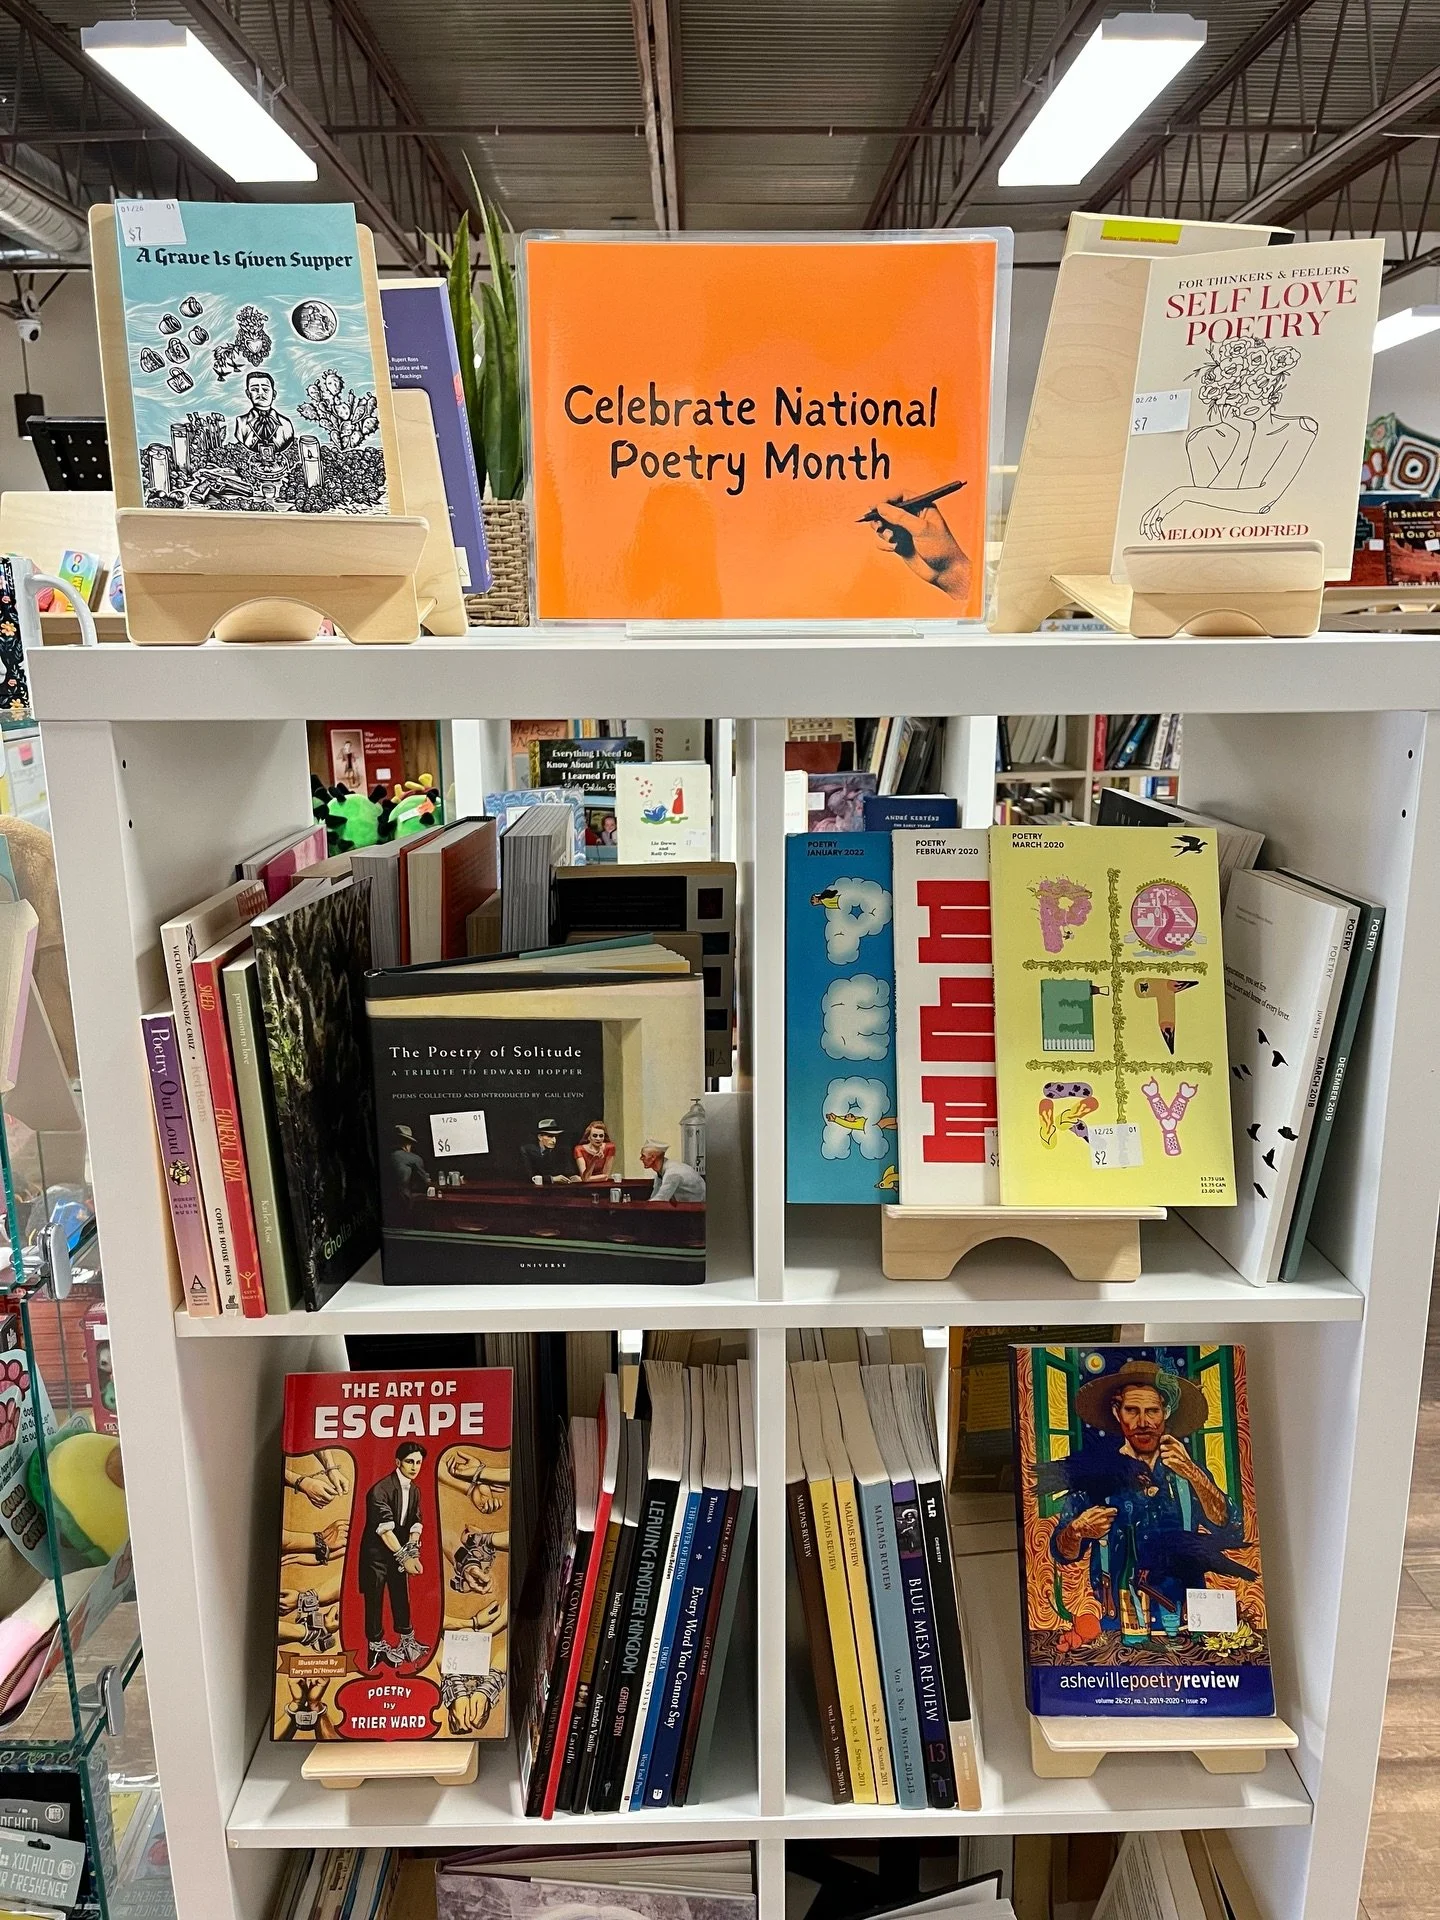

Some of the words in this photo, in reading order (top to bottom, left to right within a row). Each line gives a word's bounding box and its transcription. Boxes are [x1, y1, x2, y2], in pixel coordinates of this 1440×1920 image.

[120, 204, 144, 213] 01/26
[128, 226, 142, 243] $7
[136, 247, 153, 264] A
[155, 248, 210, 266] Grave
[235, 250, 287, 270] Given
[290, 251, 354, 272] Supper
[1178, 279, 1203, 290] FOR
[1206, 271, 1274, 287] THINKERS
[1277, 269, 1287, 280] &
[1291, 265, 1351, 279] FEELERS
[1166, 286, 1252, 320] SELF
[1260, 278, 1359, 312] LOVE
[1186, 309, 1332, 347] POETRY
[564, 382, 757, 427] Celebrate
[774, 386, 938, 429] National
[1135, 394, 1158, 404] 02/26
[1169, 393, 1179, 401] 01
[1134, 417, 1148, 431] $7
[609, 439, 746, 496] Poetry
[765, 437, 891, 481] Month
[1157, 525, 1226, 543] MELODY
[1229, 523, 1309, 539] GODFRED
[546, 761, 568, 769] Know
[570, 761, 594, 769] About
[552, 750, 594, 760] Everything
[601, 750, 622, 758] Need
[885, 814, 908, 822] ANDRÉ
[807, 849, 842, 857] JANUARY
[915, 840, 946, 848] POETRY
[1343, 918, 1356, 952] POETRY
[1366, 918, 1380, 952] POETRY
[172, 945, 183, 975] VICTOR
[1326, 945, 1338, 979] POETRY
[177, 977, 192, 1026] HERNÁNDEZ
[198, 983, 216, 1011] SNEED
[185, 1027, 196, 1050] CRUZ
[231, 992, 246, 1036] permission
[241, 1047, 252, 1065] love
[151, 1028, 171, 1077] Poetry
[389, 1046, 420, 1059] The
[428, 1046, 482, 1061] Poetry
[490, 1045, 506, 1059] of
[513, 1045, 583, 1059] Solitude
[404, 1069, 456, 1077] TRIBUTE
[483, 1068, 531, 1076] EDWARD
[537, 1068, 584, 1076] HOPPER
[1312, 1056, 1325, 1087] MARCH
[1329, 1056, 1347, 1101] DECEMBER
[160, 1080, 178, 1111] Out
[1307, 1088, 1317, 1108] 2018
[1324, 1102, 1335, 1122] 2019
[164, 1115, 185, 1156] Loud
[214, 1107, 238, 1152] FUNERAL
[1093, 1128, 1114, 1138] 12/25
[438, 1139, 451, 1153] $6
[1094, 1150, 1108, 1168] $2
[221, 1158, 242, 1182] DIVA
[214, 1207, 225, 1236] COFFEE
[219, 1236, 229, 1262] HOUSE
[324, 1222, 353, 1261] Cholla
[223, 1264, 233, 1286] PRESS
[342, 1382, 380, 1399] THE
[385, 1381, 426, 1398] ART
[430, 1380, 457, 1397] OF
[314, 1402, 484, 1440] ESCAPE
[688, 1506, 697, 1519] THE
[707, 1496, 718, 1523] THOMAS
[797, 1494, 808, 1529] MALPAIS
[821, 1501, 832, 1539] MALPAIS
[844, 1501, 855, 1538] MALPAIS
[926, 1497, 937, 1518] TLR
[641, 1500, 666, 1558] LEAVING
[684, 1520, 694, 1545] FEVER
[725, 1516, 733, 1537] TRACY
[875, 1504, 887, 1550] MALPAIS
[802, 1529, 812, 1558] REVIEW
[826, 1539, 837, 1571] REVIEW
[849, 1538, 859, 1568] REVIEW
[573, 1572, 585, 1589] PW
[676, 1557, 687, 1580] BEING
[880, 1552, 892, 1592] REVIEW
[631, 1559, 655, 1617] ANOTHER
[685, 1585, 704, 1617] Every
[908, 1578, 926, 1615] BLUE
[609, 1592, 623, 1617] healing
[560, 1590, 580, 1659] COVINGTON
[607, 1618, 616, 1639] words
[681, 1619, 698, 1647] Word
[621, 1619, 645, 1675] KINGDOM
[914, 1620, 930, 1660] MESA
[297, 1659, 327, 1668] Illustrated
[648, 1637, 660, 1675] JOYFUL
[657, 1646, 670, 1670] URREA
[678, 1649, 692, 1669] You
[368, 1686, 412, 1699] POETRY
[671, 1671, 688, 1709] Cannot
[919, 1665, 939, 1722] REVIEW
[1060, 1670, 1240, 1692] ashevillepoetryreview
[384, 1702, 396, 1710] by
[617, 1686, 630, 1714] GERALD
[641, 1681, 652, 1712] NOISE
[1114, 1698, 1133, 1706] 26-27,
[351, 1716, 388, 1729] TRIER
[390, 1716, 426, 1728] WARD
[572, 1714, 582, 1730] Ana
[591, 1693, 604, 1728] Alexandra
[664, 1709, 681, 1729] Say
[613, 1714, 625, 1737] STERN
[566, 1732, 579, 1764] Castillo
[900, 1727, 909, 1760] WINTER
[928, 1743, 946, 1763] 13
[836, 1770, 847, 1795] 2010-11
[858, 1771, 867, 1787] 2011
[880, 1772, 889, 1787] 2011
[904, 1762, 916, 1794] 2012-13
[12, 1852, 56, 1876] XOCHICO
[10, 1873, 69, 1900] FRESHENER
